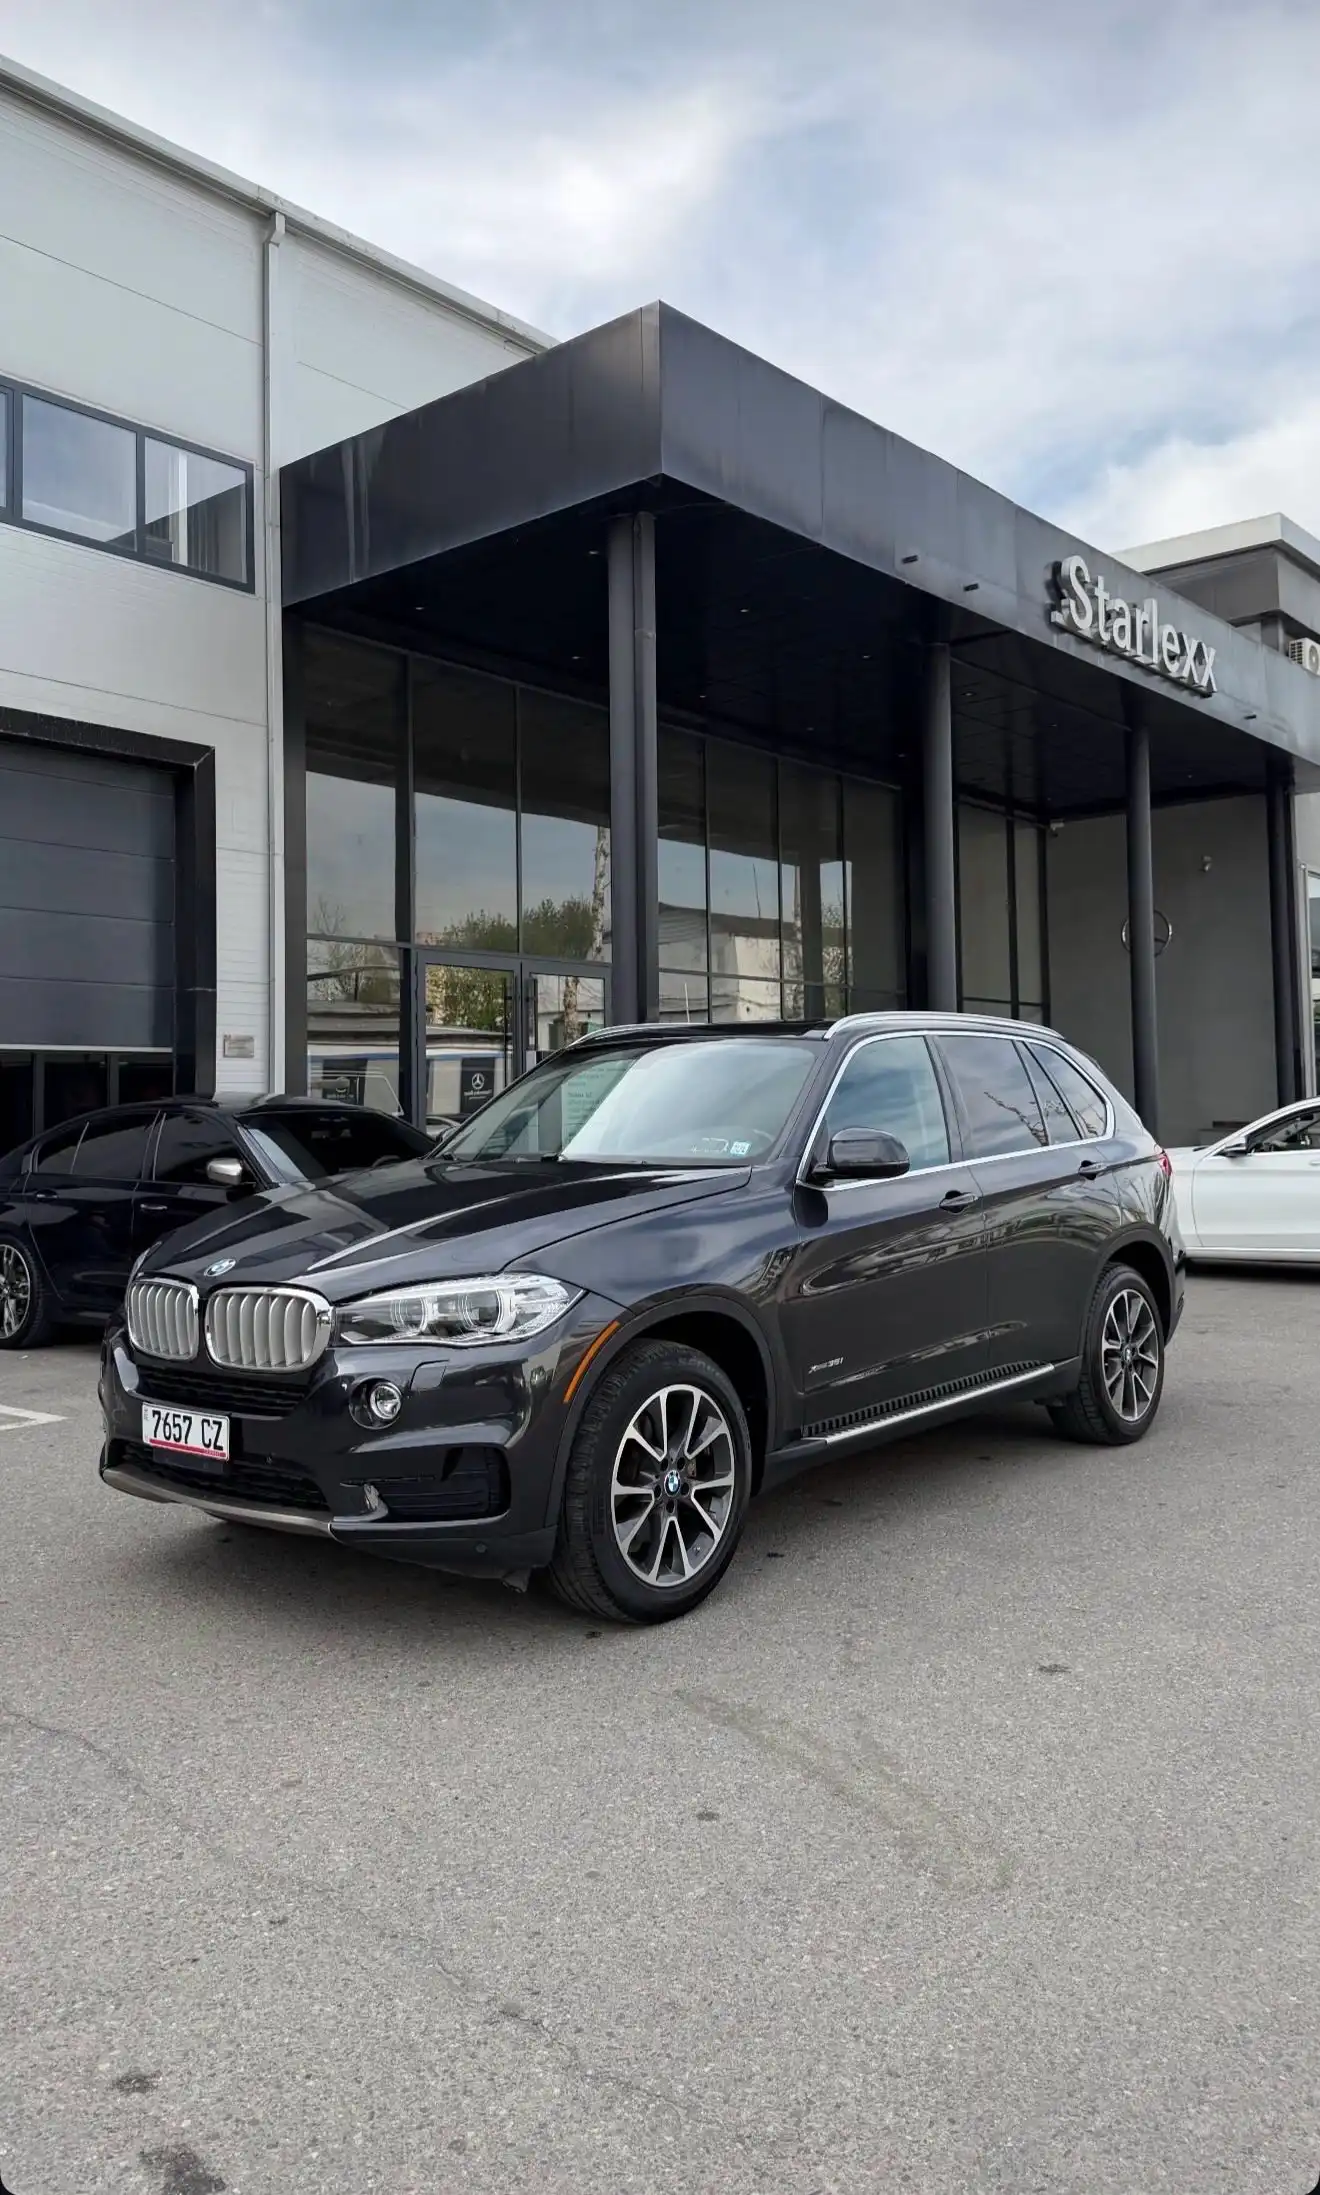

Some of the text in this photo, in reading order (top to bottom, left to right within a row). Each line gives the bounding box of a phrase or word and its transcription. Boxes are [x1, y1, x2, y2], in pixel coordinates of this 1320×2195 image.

[1060, 555, 1218, 693] Starlexx
[152, 1409, 193, 1445] 7657
[201, 1417, 224, 1451] CZ
